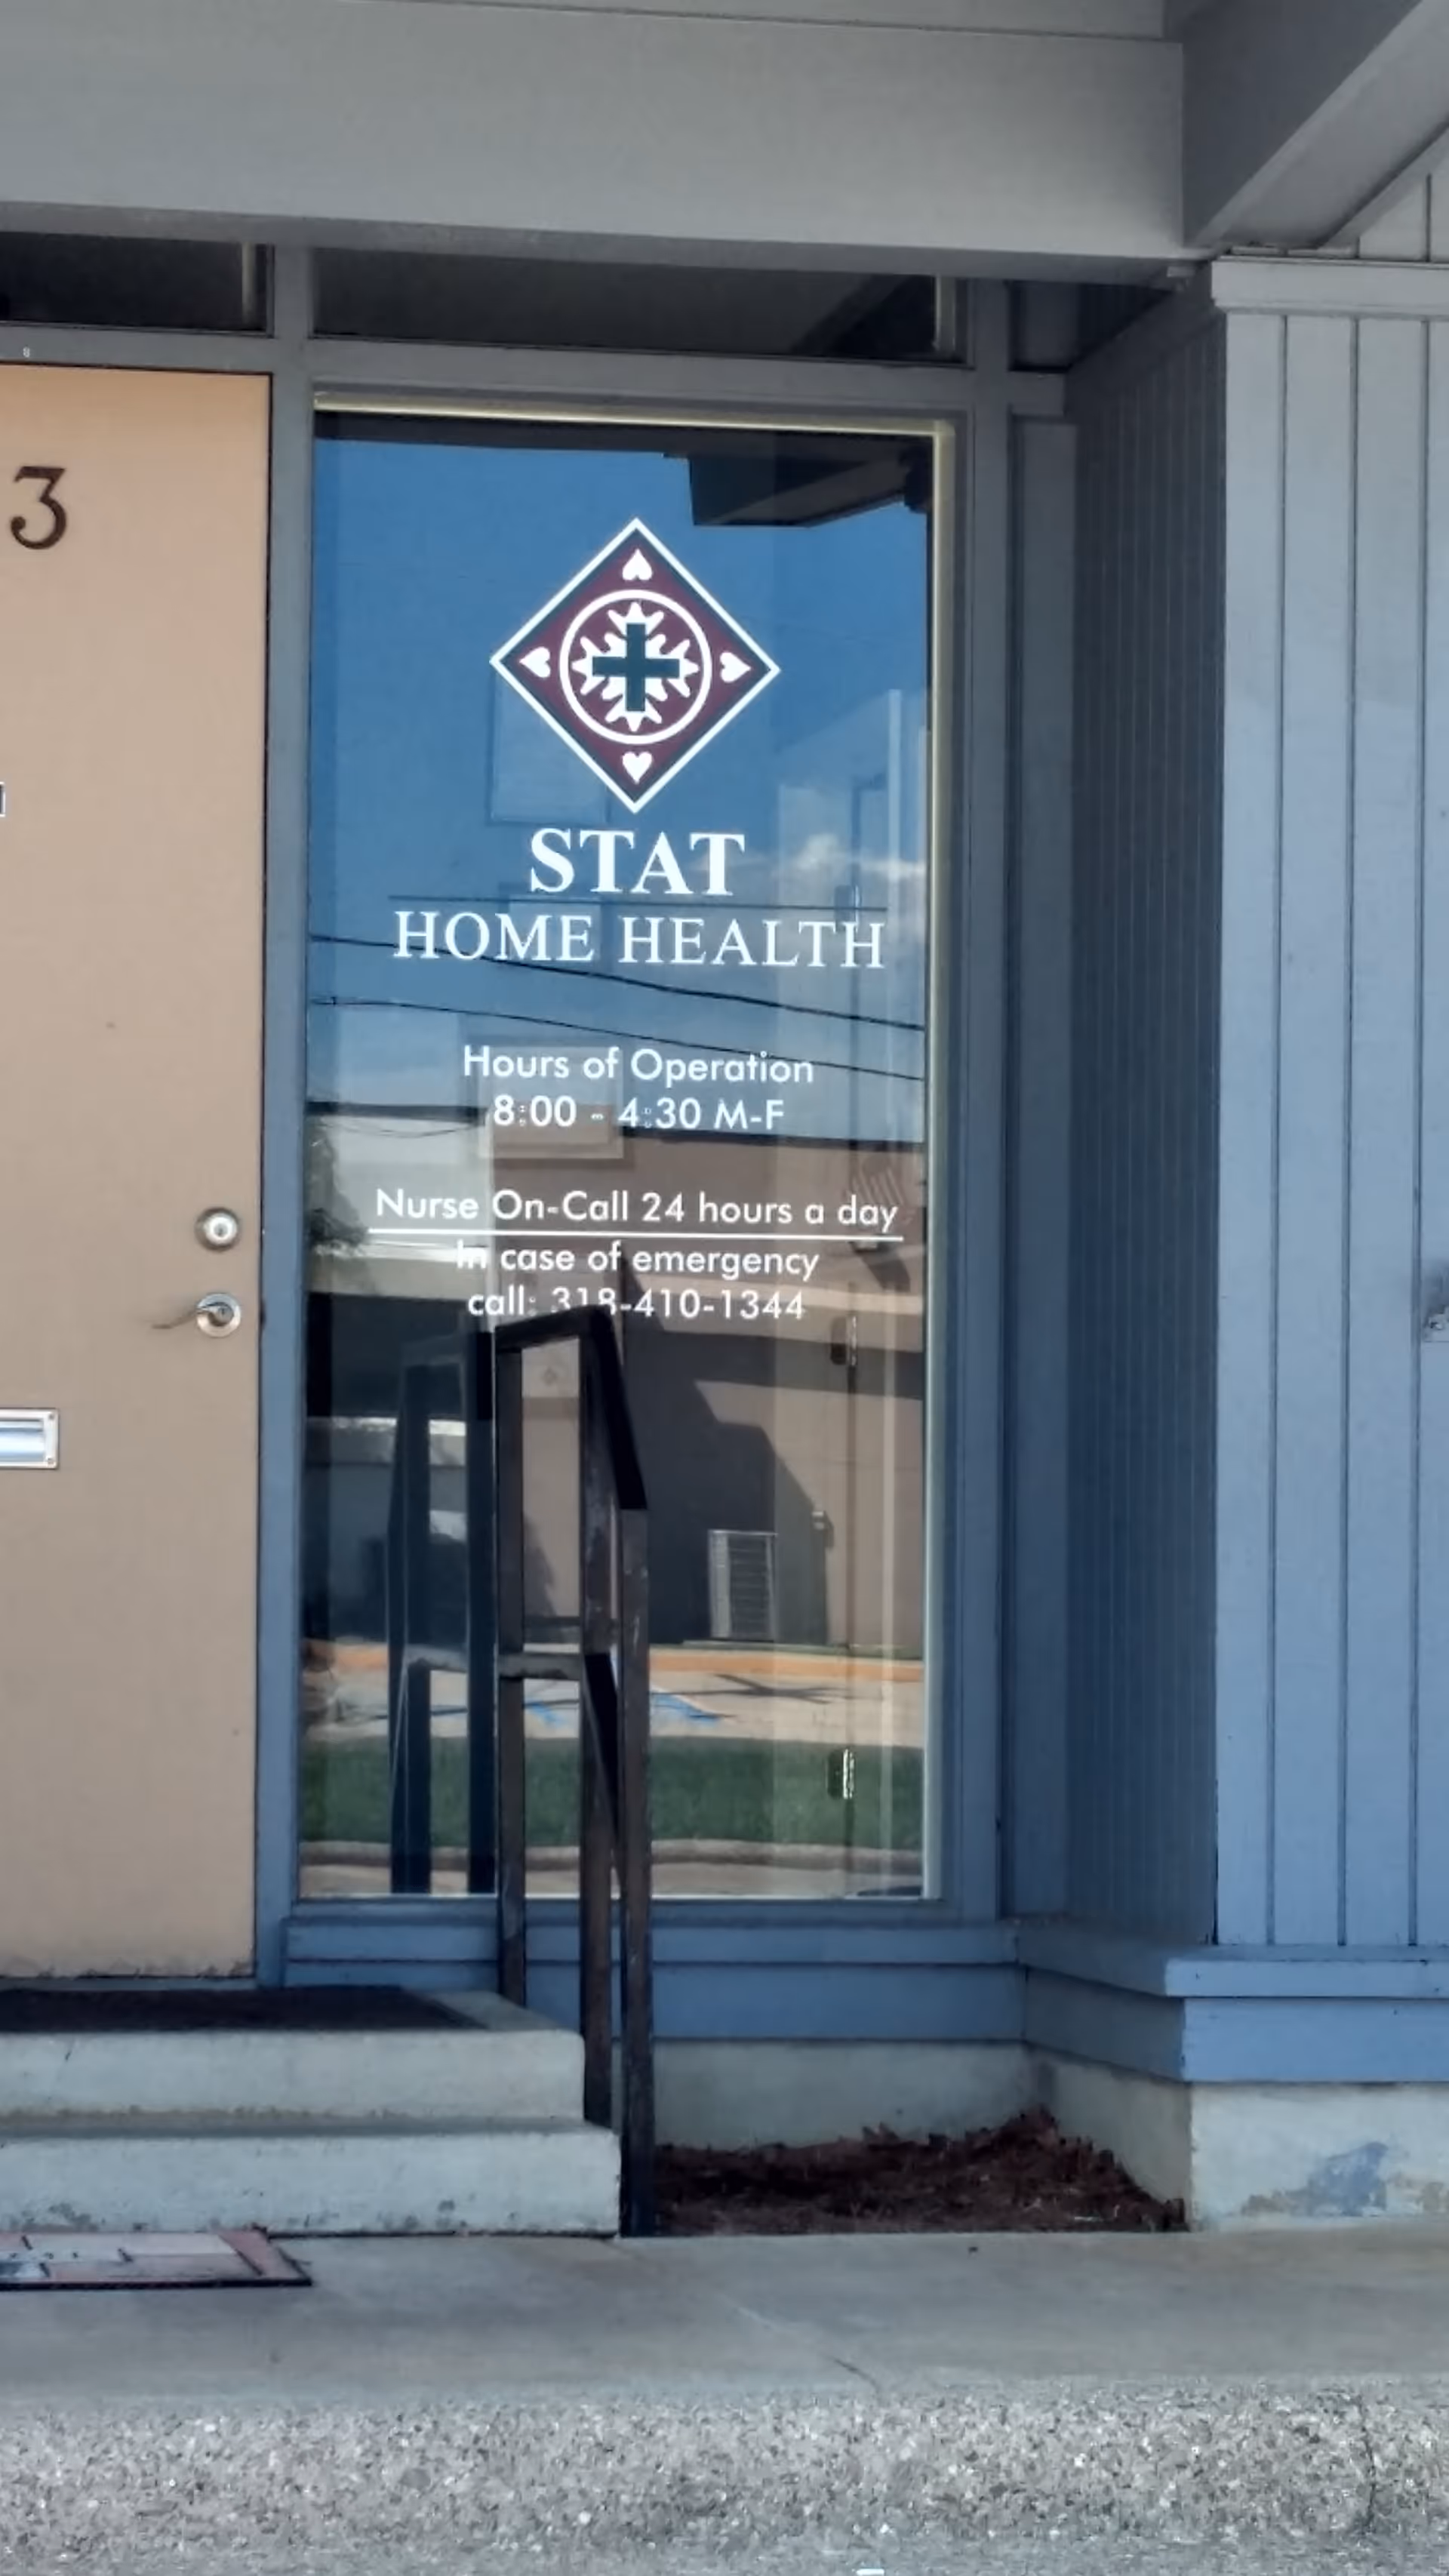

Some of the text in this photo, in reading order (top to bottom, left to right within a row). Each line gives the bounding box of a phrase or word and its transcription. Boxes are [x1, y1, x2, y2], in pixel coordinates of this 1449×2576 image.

[10, 466, 67, 549] 3
[529, 828, 746, 896] STAT
[392, 910, 885, 968] HOME HEALTH
[463, 1045, 814, 1088] Hours of Operation
[493, 1094, 577, 1127] 8:00
[618, 1097, 701, 1129] 4:30
[714, 1100, 784, 1130] M-F
[377, 1188, 898, 1233] Nurse On-Call 24 hours a day
[457, 1240, 820, 1281] In case of emergency
[467, 1285, 806, 1319] call: 318-410-1344
